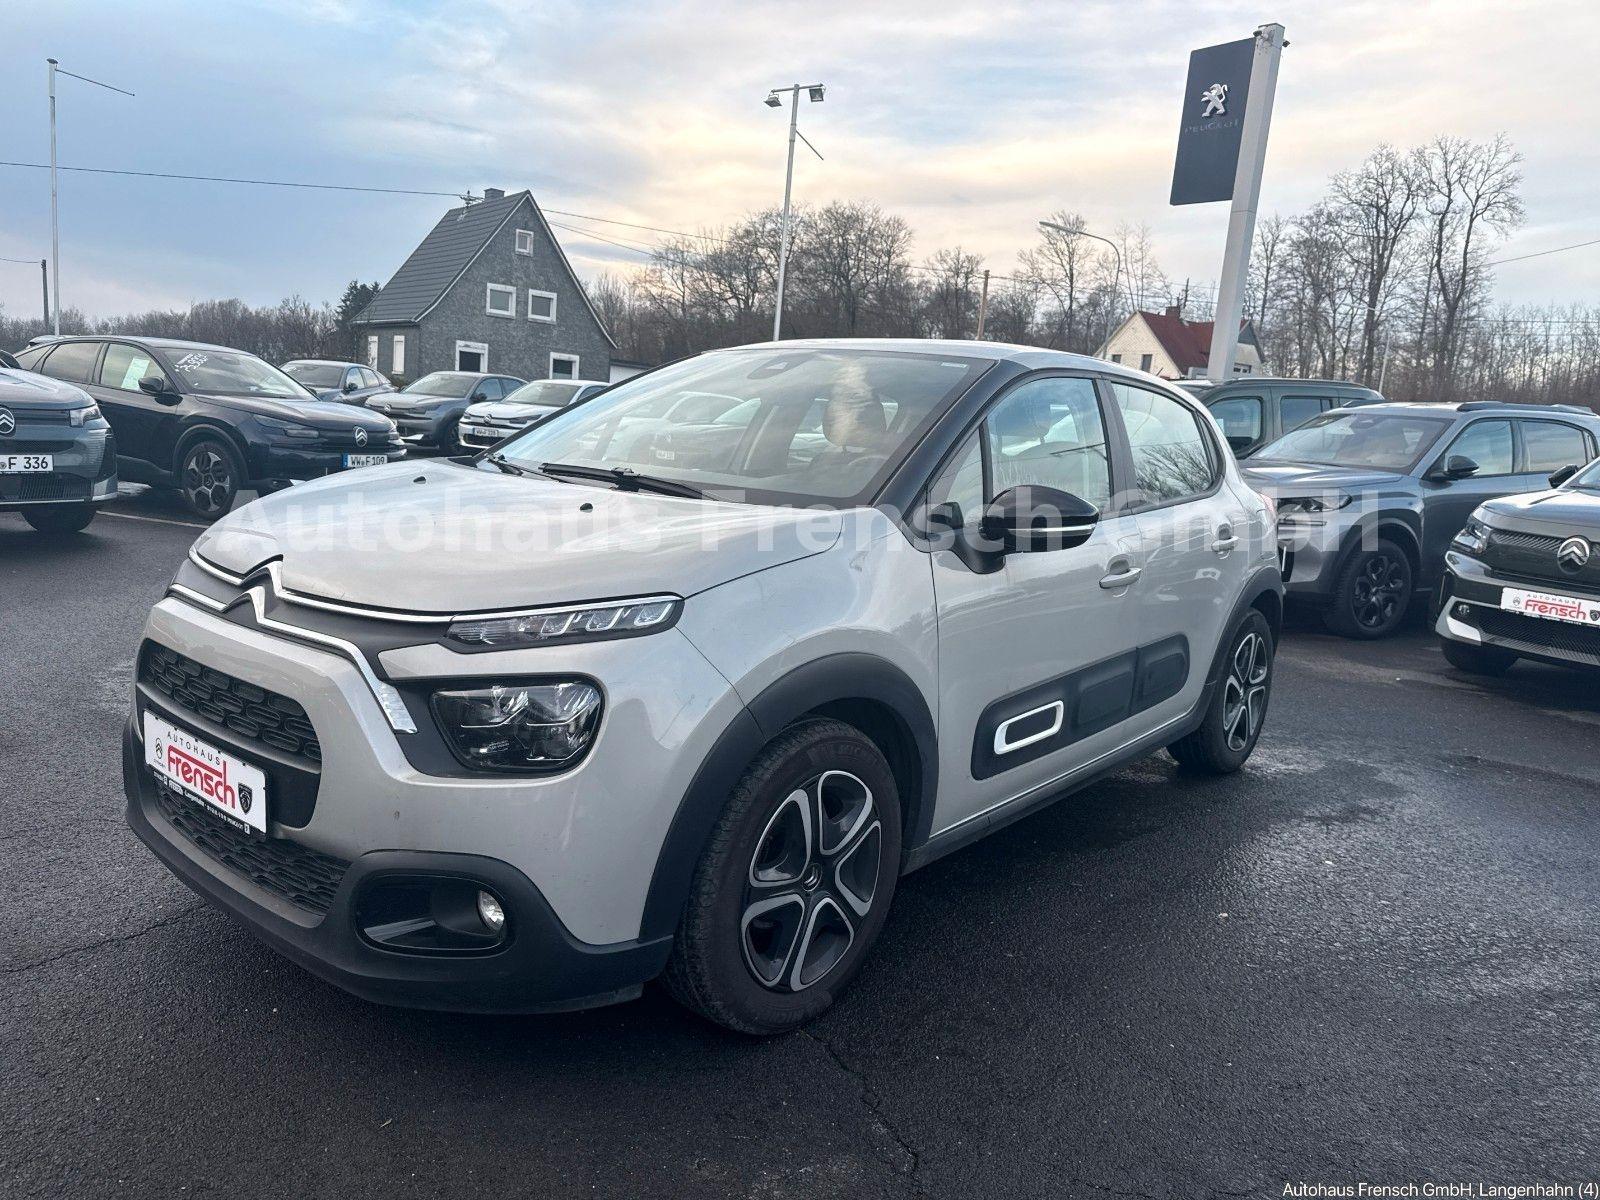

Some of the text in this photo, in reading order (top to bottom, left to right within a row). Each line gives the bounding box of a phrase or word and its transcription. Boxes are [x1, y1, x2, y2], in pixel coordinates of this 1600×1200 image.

[8, 456, 48, 469] F 336
[1525, 599, 1587, 620] Frensch
[1526, 593, 1576, 605] AUTOHAUS
[166, 731, 221, 766] AUTOHAUS
[167, 745, 236, 809] Frensch
